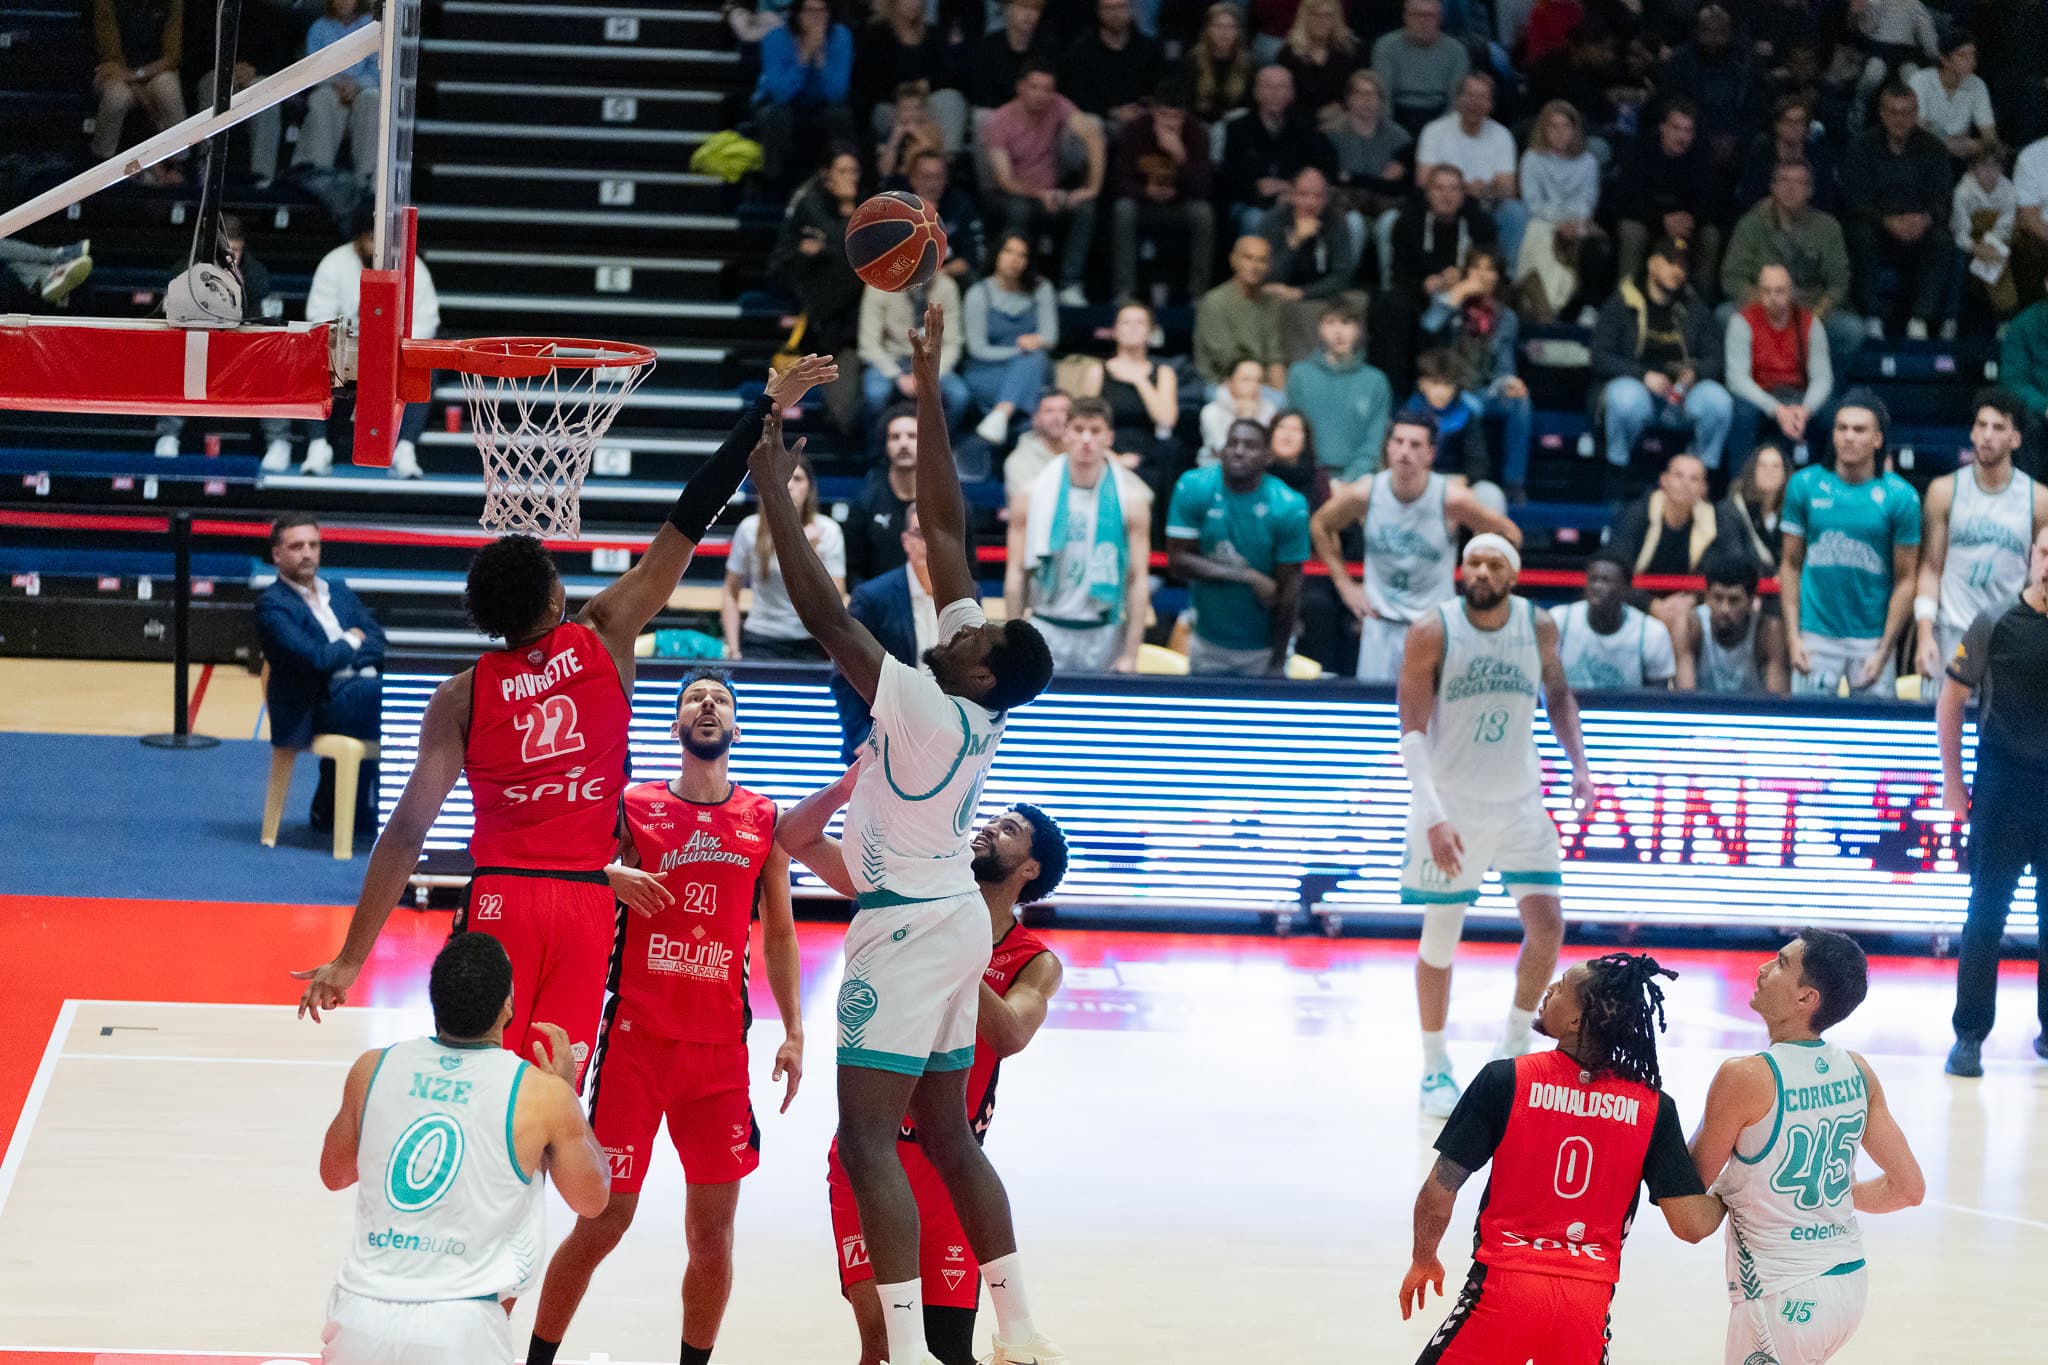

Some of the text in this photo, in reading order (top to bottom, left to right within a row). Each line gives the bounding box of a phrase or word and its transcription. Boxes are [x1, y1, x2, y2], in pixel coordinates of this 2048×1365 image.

[502, 648, 583, 702] PAVRETTE
[513, 694, 586, 763] 22
[1474, 710, 1510, 743] 13
[502, 770, 606, 806] SPIE
[1541, 766, 1829, 868] AINT
[682, 829, 723, 854] Aix
[658, 847, 751, 874] Maurienne
[477, 893, 504, 921] 22
[683, 881, 718, 916] 24
[647, 932, 734, 969] Bourille
[408, 1071, 473, 1105] NZE
[1528, 1081, 1640, 1127] DONALDSON
[1784, 1074, 1865, 1113] CORNELY
[384, 1112, 465, 1213] 0
[1553, 1135, 1594, 1199] 0
[1769, 1109, 1867, 1211] 45
[368, 1228, 467, 1257] edenauto
[1780, 1299, 1817, 1325] 45
